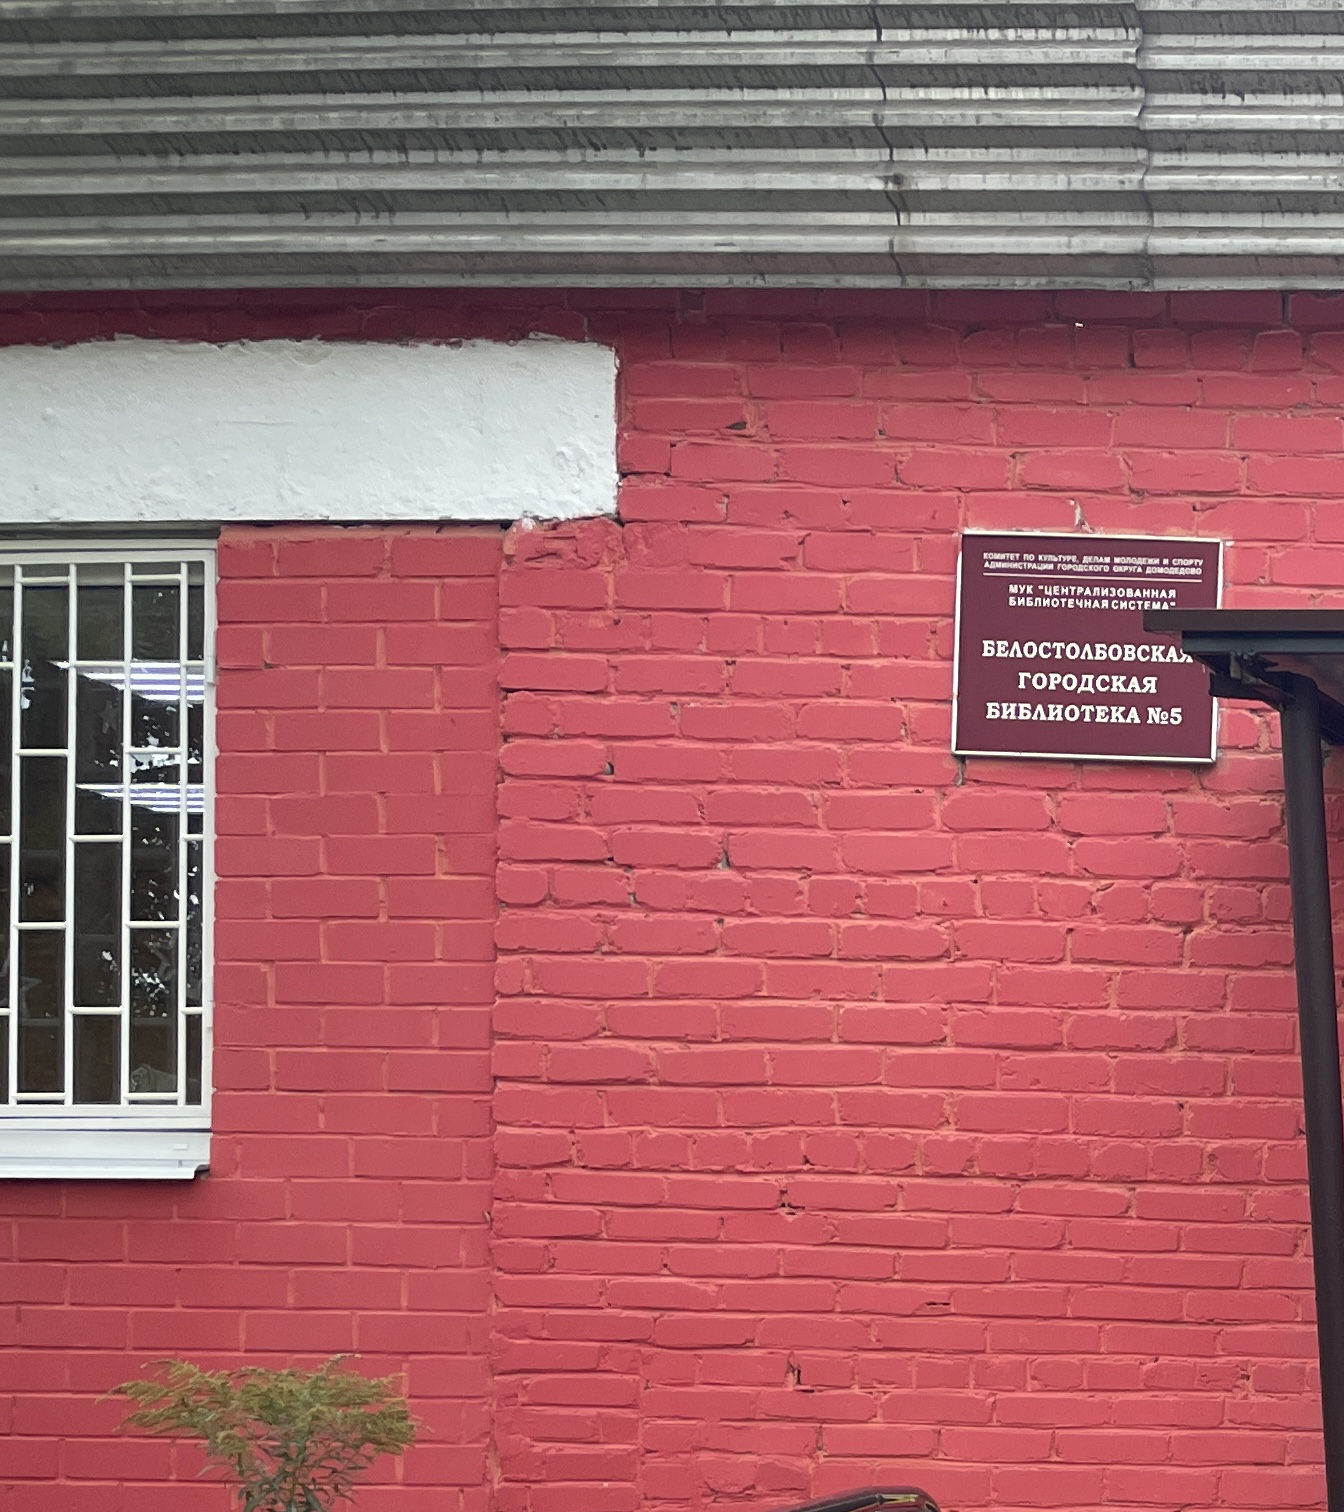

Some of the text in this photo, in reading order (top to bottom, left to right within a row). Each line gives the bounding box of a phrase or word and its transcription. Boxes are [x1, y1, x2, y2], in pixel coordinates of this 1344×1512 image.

[983, 552, 1020, 560] КОМИТЕТ
[1023, 553, 1035, 561] ПО
[1082, 555, 1111, 564] ДЕЛАМ
[1172, 558, 1204, 566] СПОРТУ
[984, 561, 1202, 575] АДМИНИСТРАЦИИ ГОРОДСКОГО ОКРУГА ДОМОДЕДОВО
[1009, 584, 1176, 598] МУК "ЦЕНТРАЛИЗОВАННАЯ
[1009, 597, 1176, 610] БИБЛИОТЕЧНАЯ СИСТЕМА"
[1018, 672, 1158, 694] ГОРОДСКАЯ
[986, 702, 1183, 725] БИБЛИОТЕКА №5
